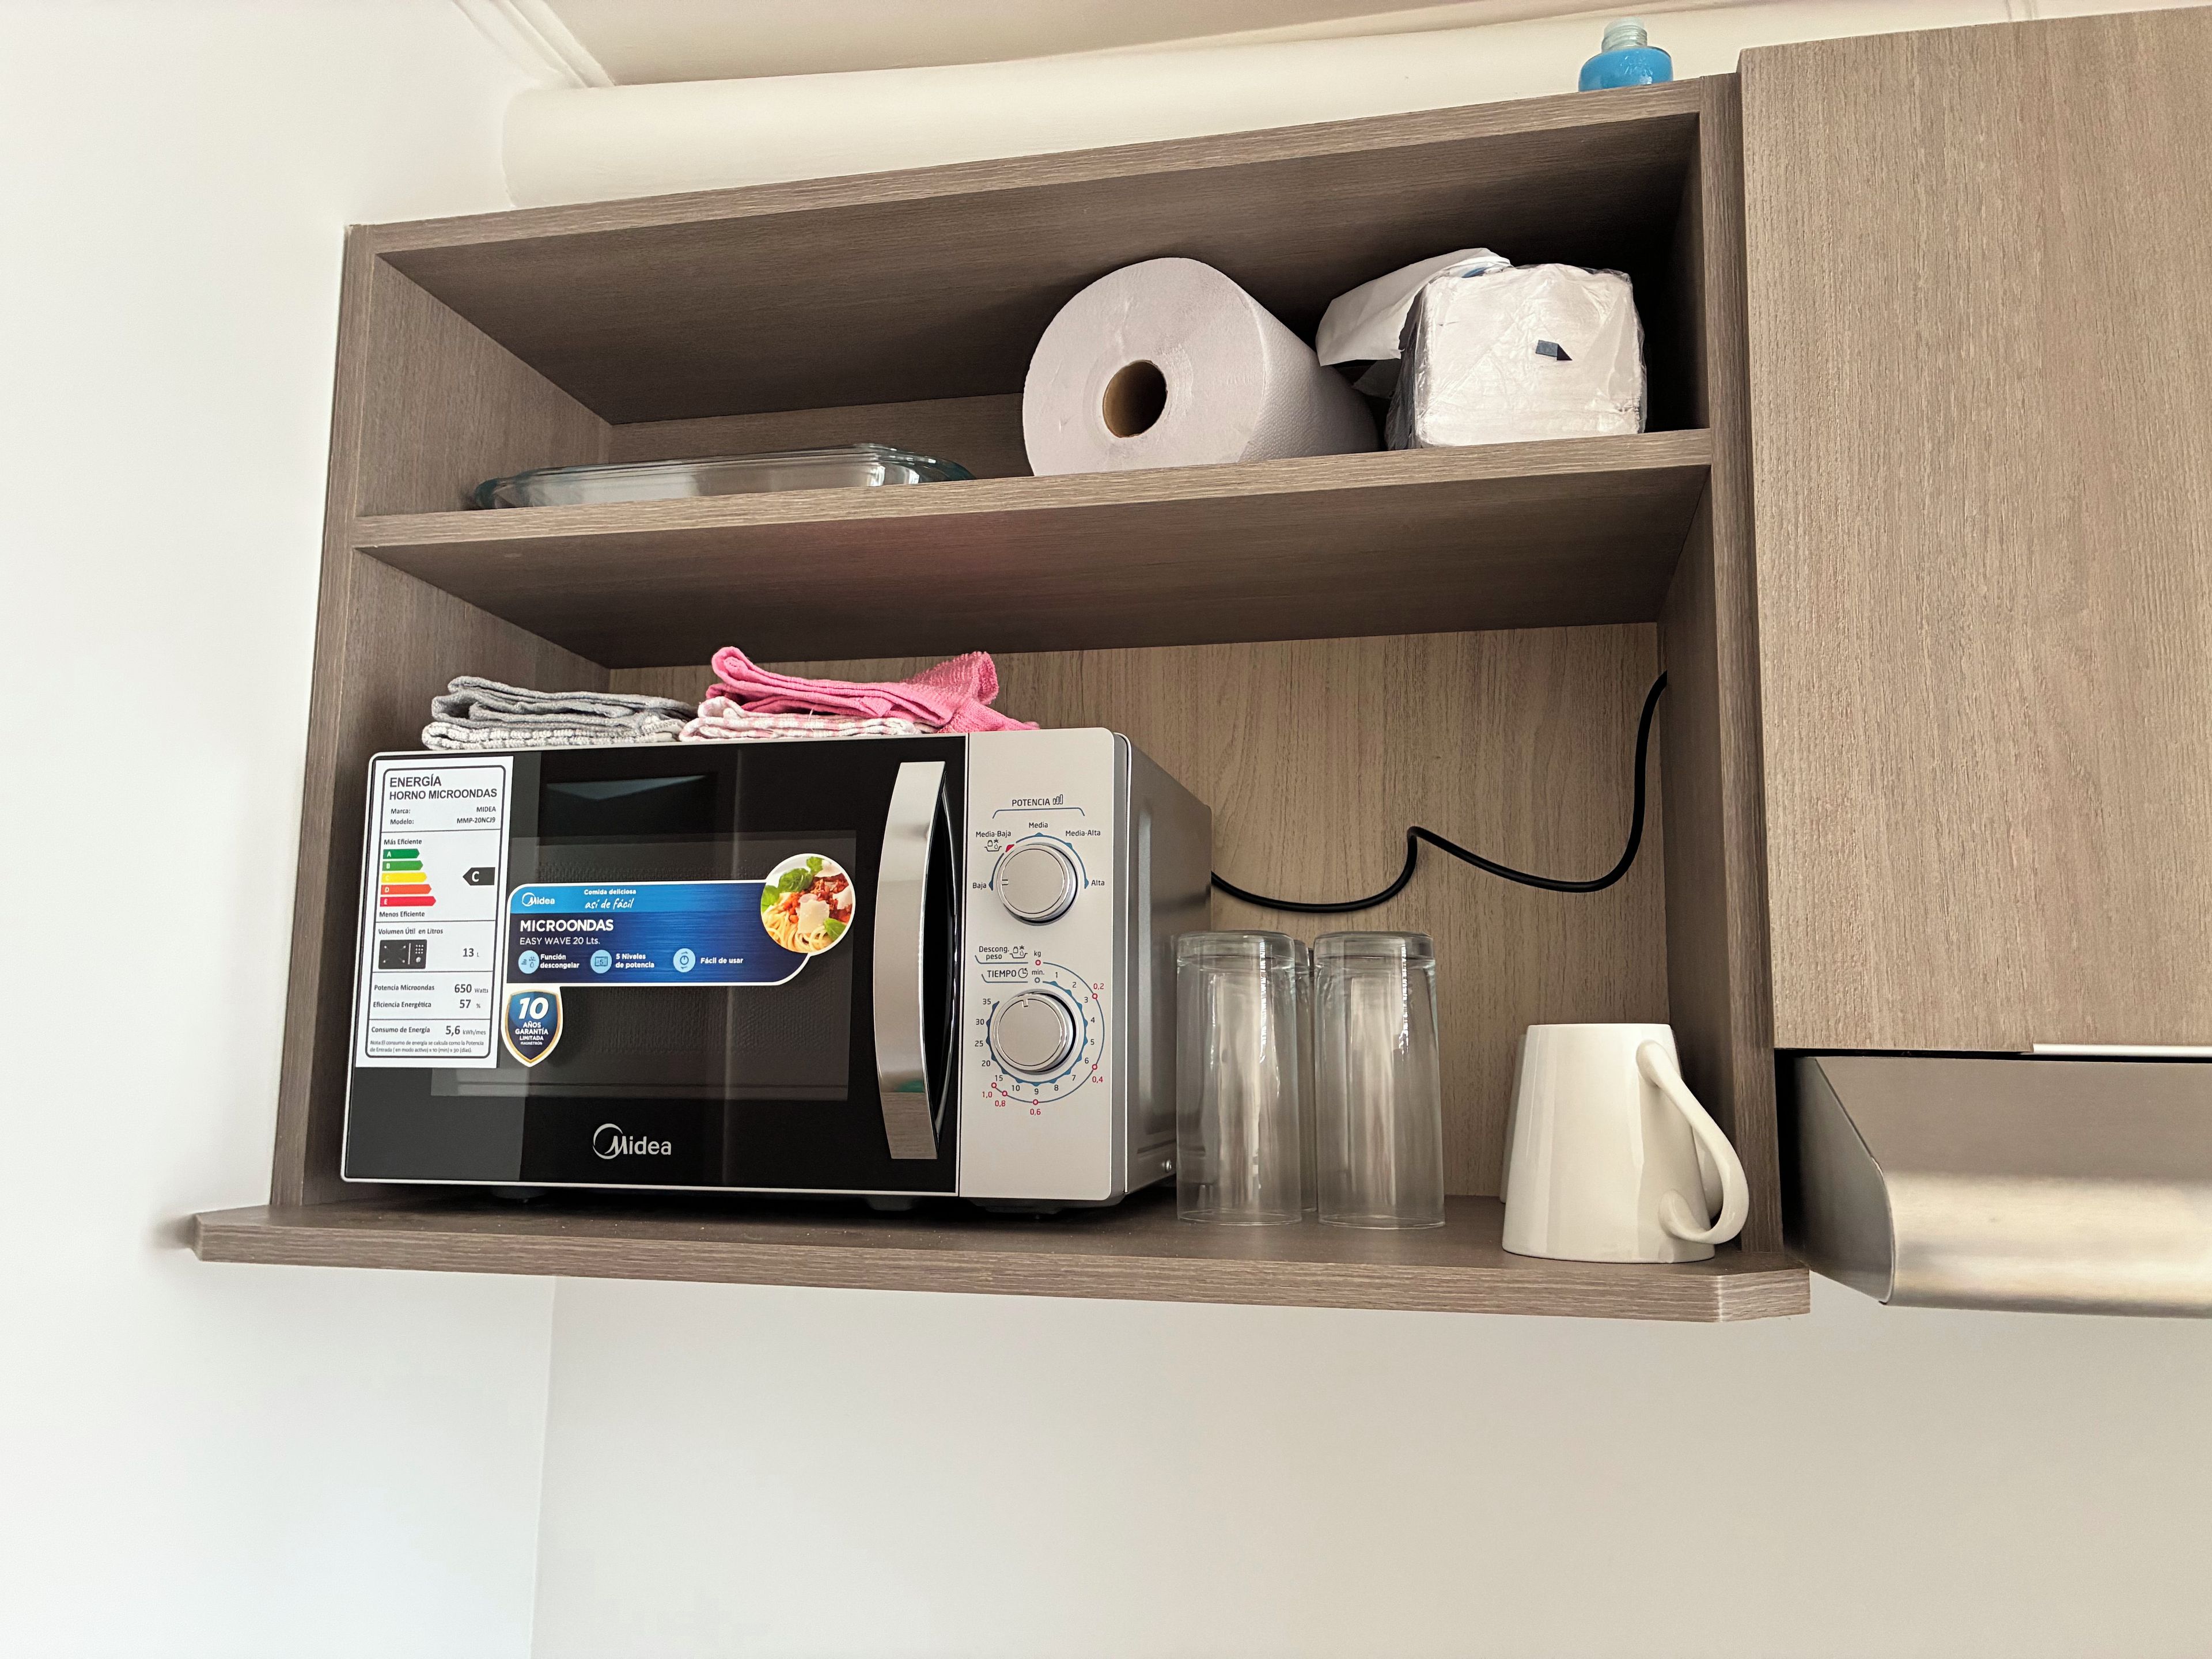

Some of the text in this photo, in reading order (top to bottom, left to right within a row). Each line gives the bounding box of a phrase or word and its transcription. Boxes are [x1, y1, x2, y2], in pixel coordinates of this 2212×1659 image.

[389, 774, 442, 787] ENERGÍA
[389, 789, 497, 800] HORNO MICROONDAS
[1012, 798, 1050, 806] POTENCIA
[471, 871, 480, 882] C
[522, 892, 555, 907] Midea
[585, 897, 634, 910] así de fácil
[520, 919, 614, 932] MICROONDAS
[544, 937, 571, 945] WAVE
[573, 937, 584, 945] 20
[586, 937, 600, 945] Lts.
[463, 948, 474, 957] 13
[626, 961, 654, 969] potencia
[454, 984, 472, 993] 650
[460, 999, 471, 1008] 57
[518, 997, 549, 1020] 10
[408, 1026, 430, 1034] Energía
[445, 1025, 460, 1036] 5,6
[593, 1123, 672, 1160] Midea
